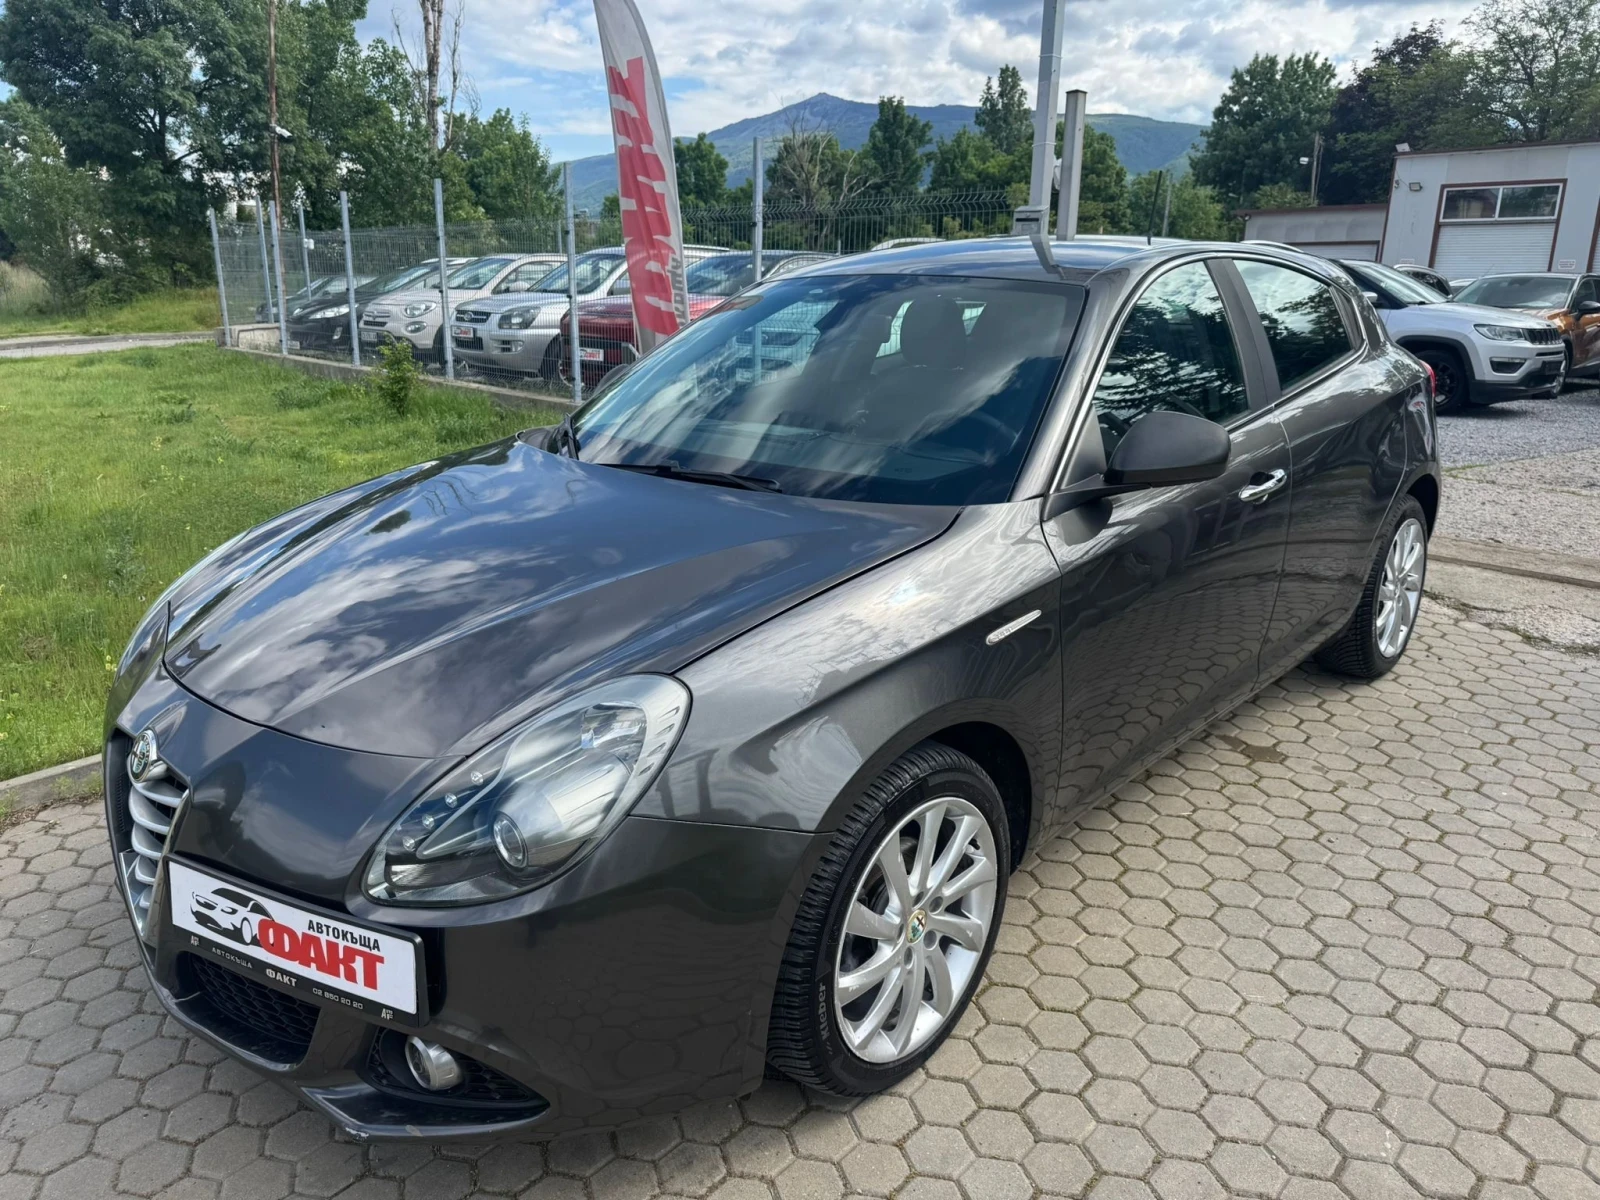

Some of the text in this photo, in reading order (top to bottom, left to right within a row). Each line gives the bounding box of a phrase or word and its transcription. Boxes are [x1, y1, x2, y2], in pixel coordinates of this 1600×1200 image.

[308, 919, 381, 952] АВТОКЪЩА
[257, 918, 385, 990] ФАКТ
[265, 968, 297, 987] ФАКТ
[312, 987, 323, 997] 02
[340, 997, 351, 1006] 20
[352, 1001, 363, 1010] 20
[818, 982, 830, 1040] Kleber
